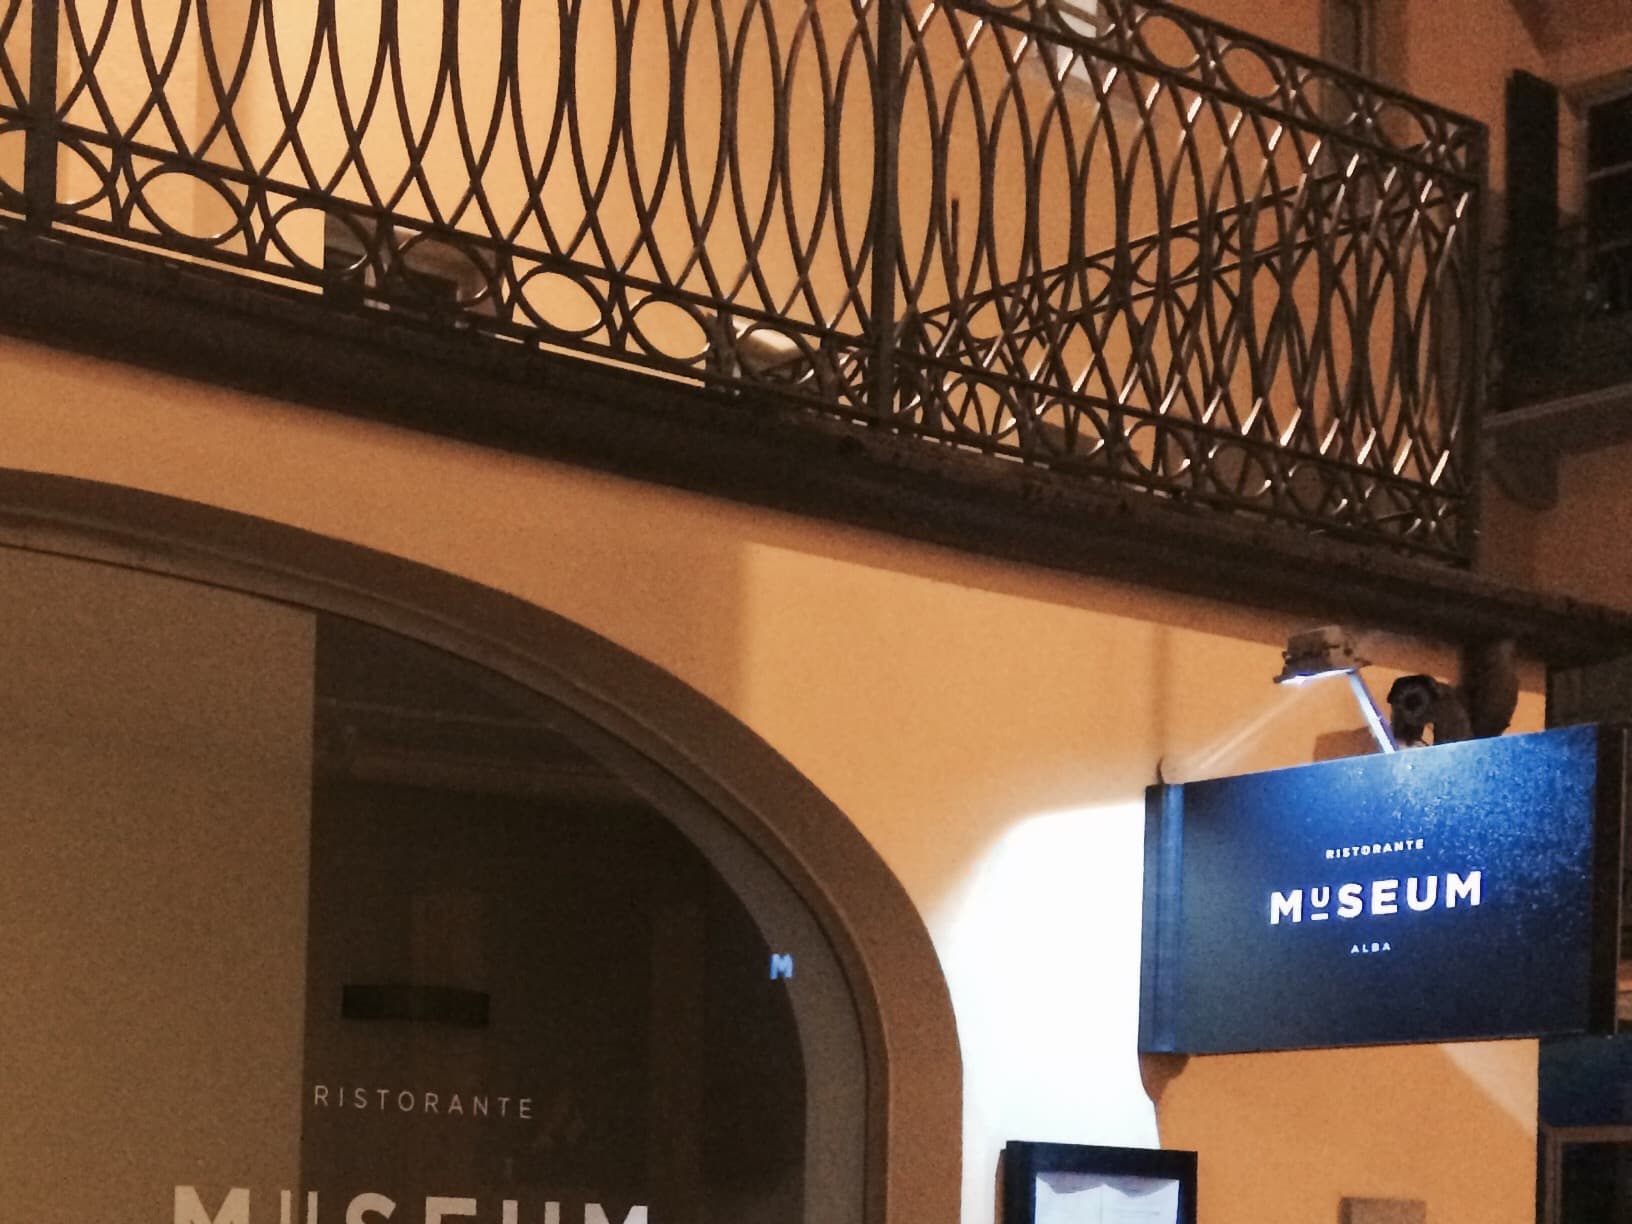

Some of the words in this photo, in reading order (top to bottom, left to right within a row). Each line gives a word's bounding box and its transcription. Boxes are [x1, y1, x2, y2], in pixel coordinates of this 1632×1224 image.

[1325, 838, 1425, 860] RISTORANTE
[1269, 870, 1482, 925] MUSEUM
[1350, 941, 1391, 955] ALBA
[313, 1084, 535, 1120] RISTORANTE
